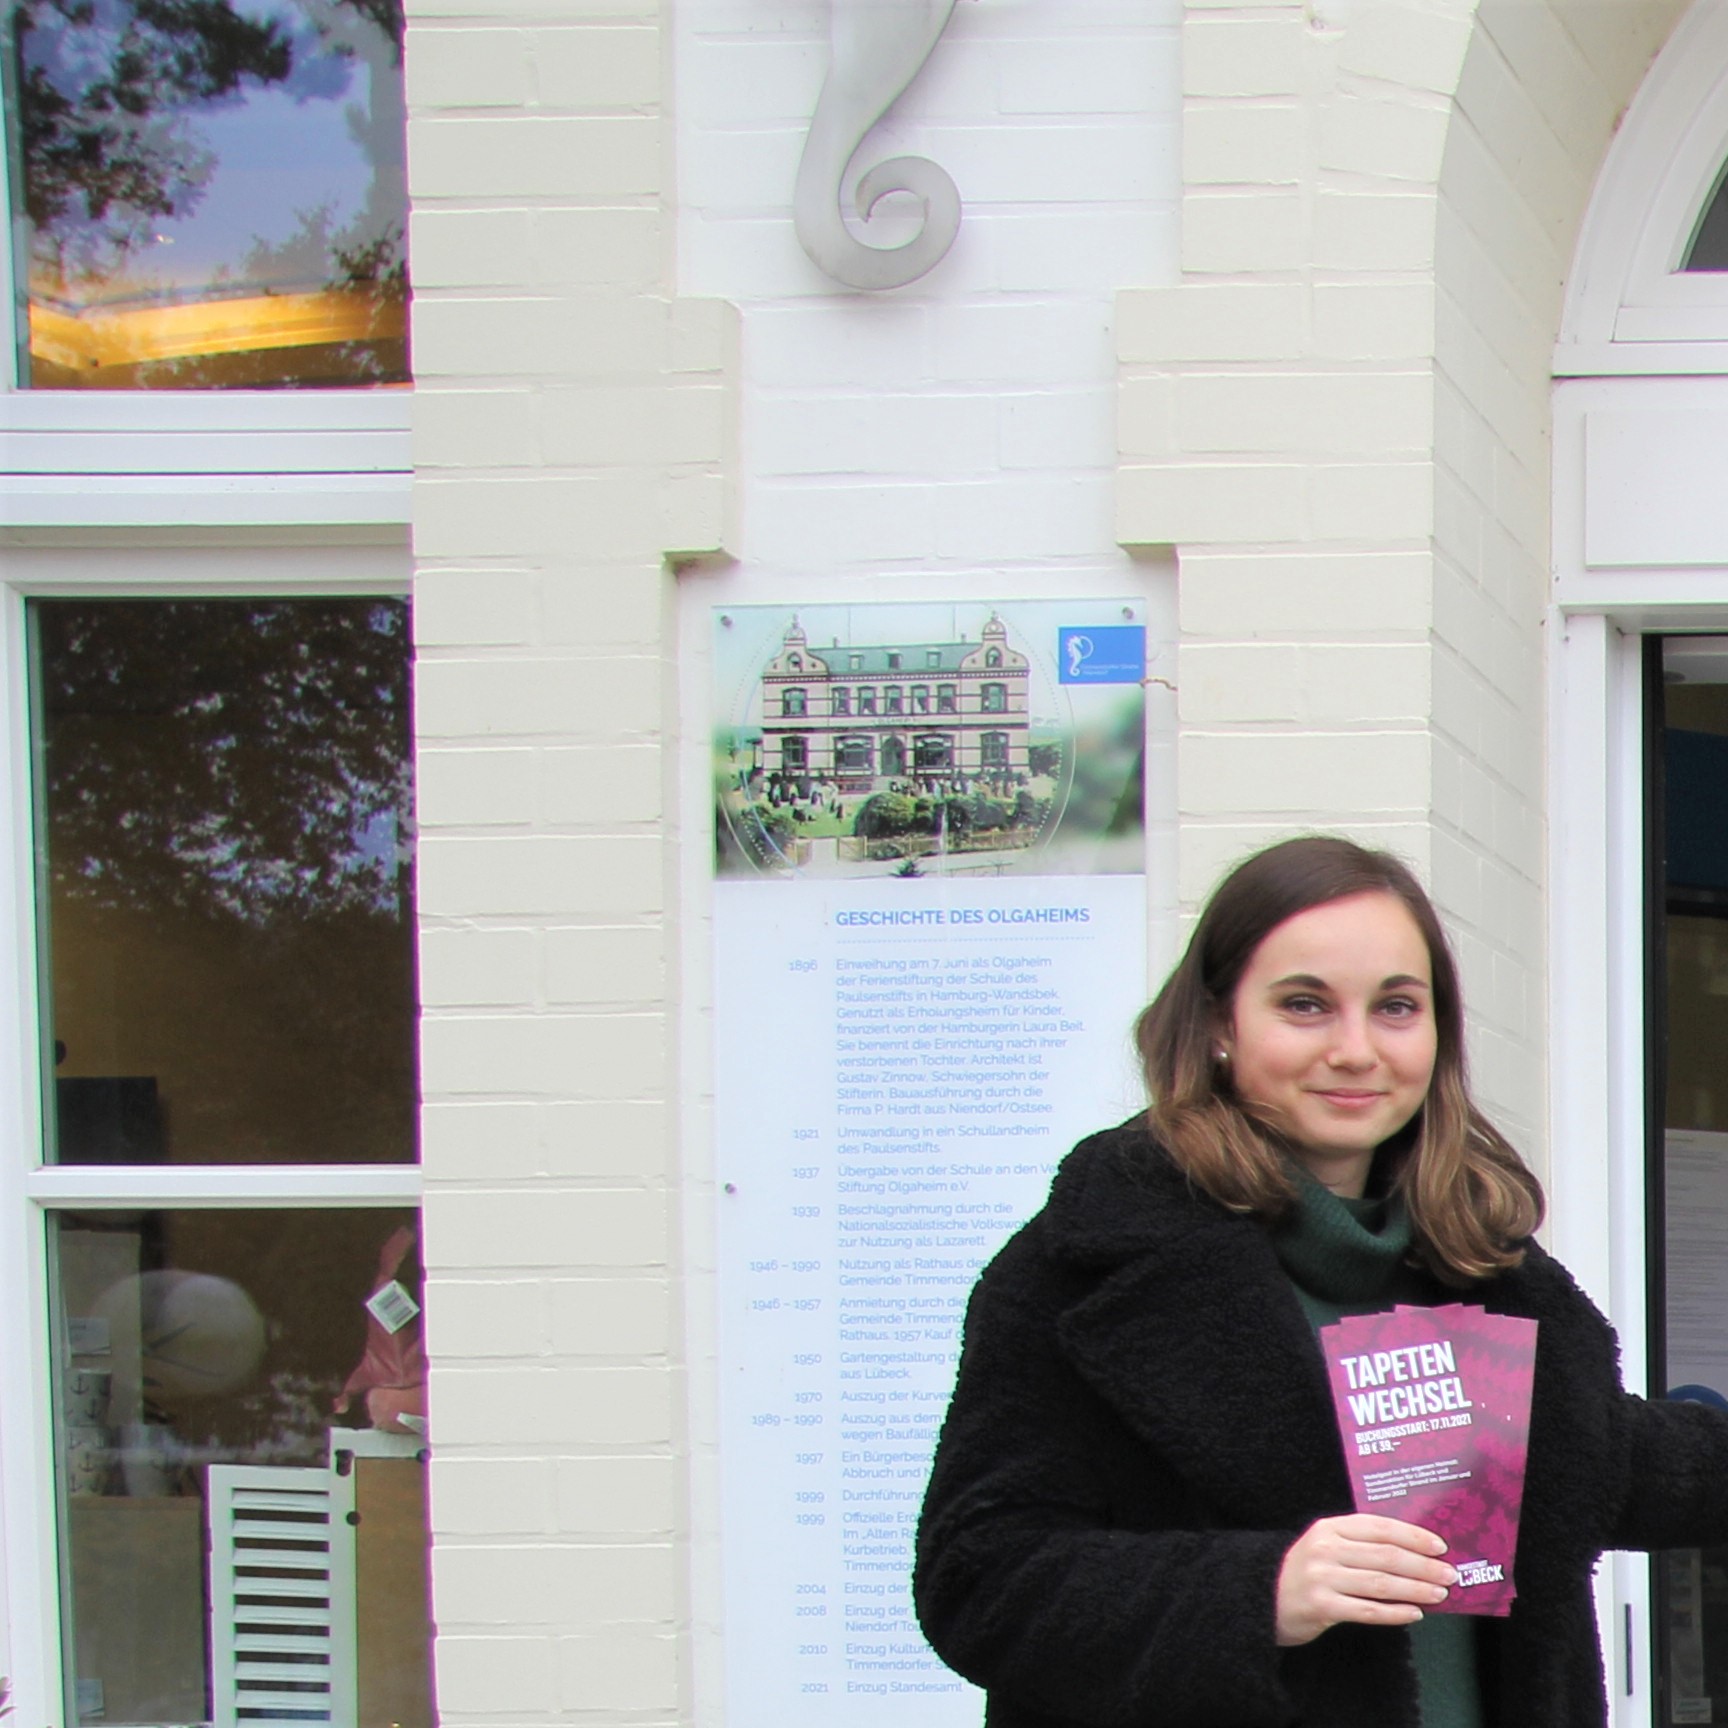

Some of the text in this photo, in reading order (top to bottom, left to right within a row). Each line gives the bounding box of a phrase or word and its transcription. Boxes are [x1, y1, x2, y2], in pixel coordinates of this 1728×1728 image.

[836, 907, 1090, 926] GESCHICHTE DES OLGAHEIMS
[789, 959, 818, 973] 1896
[835, 958, 906, 972] Einweihung
[910, 959, 930, 969] am
[972, 957, 990, 969] als
[992, 956, 1052, 970] Olgaheim
[836, 972, 1037, 988] der Ferienstiftung der Schule des
[836, 988, 913, 1002] Paulsenstifts
[916, 989, 927, 1001] in
[836, 1005, 884, 1019] Genutzt
[887, 1005, 905, 1017] als
[907, 1004, 1000, 1020] Erholungsheim
[1002, 1004, 1020, 1017] für
[892, 1024, 915, 1034] von
[918, 1021, 938, 1034] der
[941, 1020, 1020, 1036] Hamburgerin
[1023, 1020, 1056, 1033] Laura
[836, 1036, 1067, 1052] Sie benennt die Einrichtung nach ihrer
[836, 1054, 918, 1067] verstorbenen
[970, 1053, 1025, 1066] Architekt
[1028, 1053, 1042, 1065] ist
[837, 1070, 879, 1084] Gustav
[931, 1069, 1026, 1086] Schwiegersohn
[1029, 1069, 1050, 1082] der
[889, 1085, 982, 1102] Bauausführung
[985, 1085, 1024, 1098] durch
[1025, 1085, 1043, 1098] die
[837, 1103, 872, 1116] Firma
[887, 1102, 922, 1115] Hardt
[924, 1105, 946, 1115] aus
[793, 1129, 819, 1141] 1921
[837, 1124, 1049, 1140] Umwandlung in ein Schullandheim
[837, 1141, 859, 1154] des
[792, 1167, 820, 1179] 1937
[837, 1162, 1037, 1178] Übergabe von der Schule an den
[837, 1180, 885, 1195] Stiftung
[888, 1179, 947, 1195] Olgaheim
[792, 1206, 820, 1217] 1939
[838, 1201, 1013, 1218] Beschlagnahmung durch die
[838, 1218, 968, 1232] Nationalsozialistische
[838, 1235, 933, 1250] zur Nutzung als
[750, 1259, 821, 1272] 1946 1990
[838, 1257, 960, 1273] Nutzung als Rathaus
[839, 1274, 901, 1287] Gemeinde
[752, 1298, 821, 1311] 1946 1957
[839, 1296, 902, 1312] Anmietung
[904, 1295, 945, 1309] durch
[839, 1312, 902, 1325] Gemeinde
[893, 1330, 921, 1342] 1957
[924, 1328, 953, 1341] Kauf
[793, 1353, 822, 1365] 1950
[840, 1352, 946, 1366] Gartengestaltung
[1340, 1341, 1456, 1389] TAPETEN
[840, 1369, 862, 1379] aus
[795, 1392, 822, 1404] 1970
[841, 1390, 909, 1404] Auszug der
[1348, 1377, 1472, 1426] WECHSEL
[752, 1414, 823, 1427] 1989 1990
[841, 1413, 887, 1427] Auszug
[889, 1414, 911, 1424] aus
[841, 1431, 883, 1442] wegen
[1358, 1443, 1371, 1456] AB
[796, 1453, 823, 1464] 1997
[841, 1451, 860, 1463] Ein
[842, 1467, 920, 1479] Abbruch und
[796, 1491, 824, 1503] 1999
[796, 1514, 825, 1525] 1999
[842, 1512, 894, 1524] Offizielle
[1458, 1564, 1505, 1587] LÜBECK
[796, 1584, 826, 1595] 2004
[844, 1583, 908, 1596] Einzug der
[796, 1606, 827, 1617] 2008
[844, 1605, 908, 1619] Einzug der
[845, 1621, 898, 1632] Niendorf
[799, 1645, 828, 1656] 2010
[846, 1644, 886, 1657] Einzug
[847, 1659, 932, 1671] Timmendorfer
[801, 1683, 829, 1693] 2021
[847, 1681, 963, 1696] Einzug Standesamt
